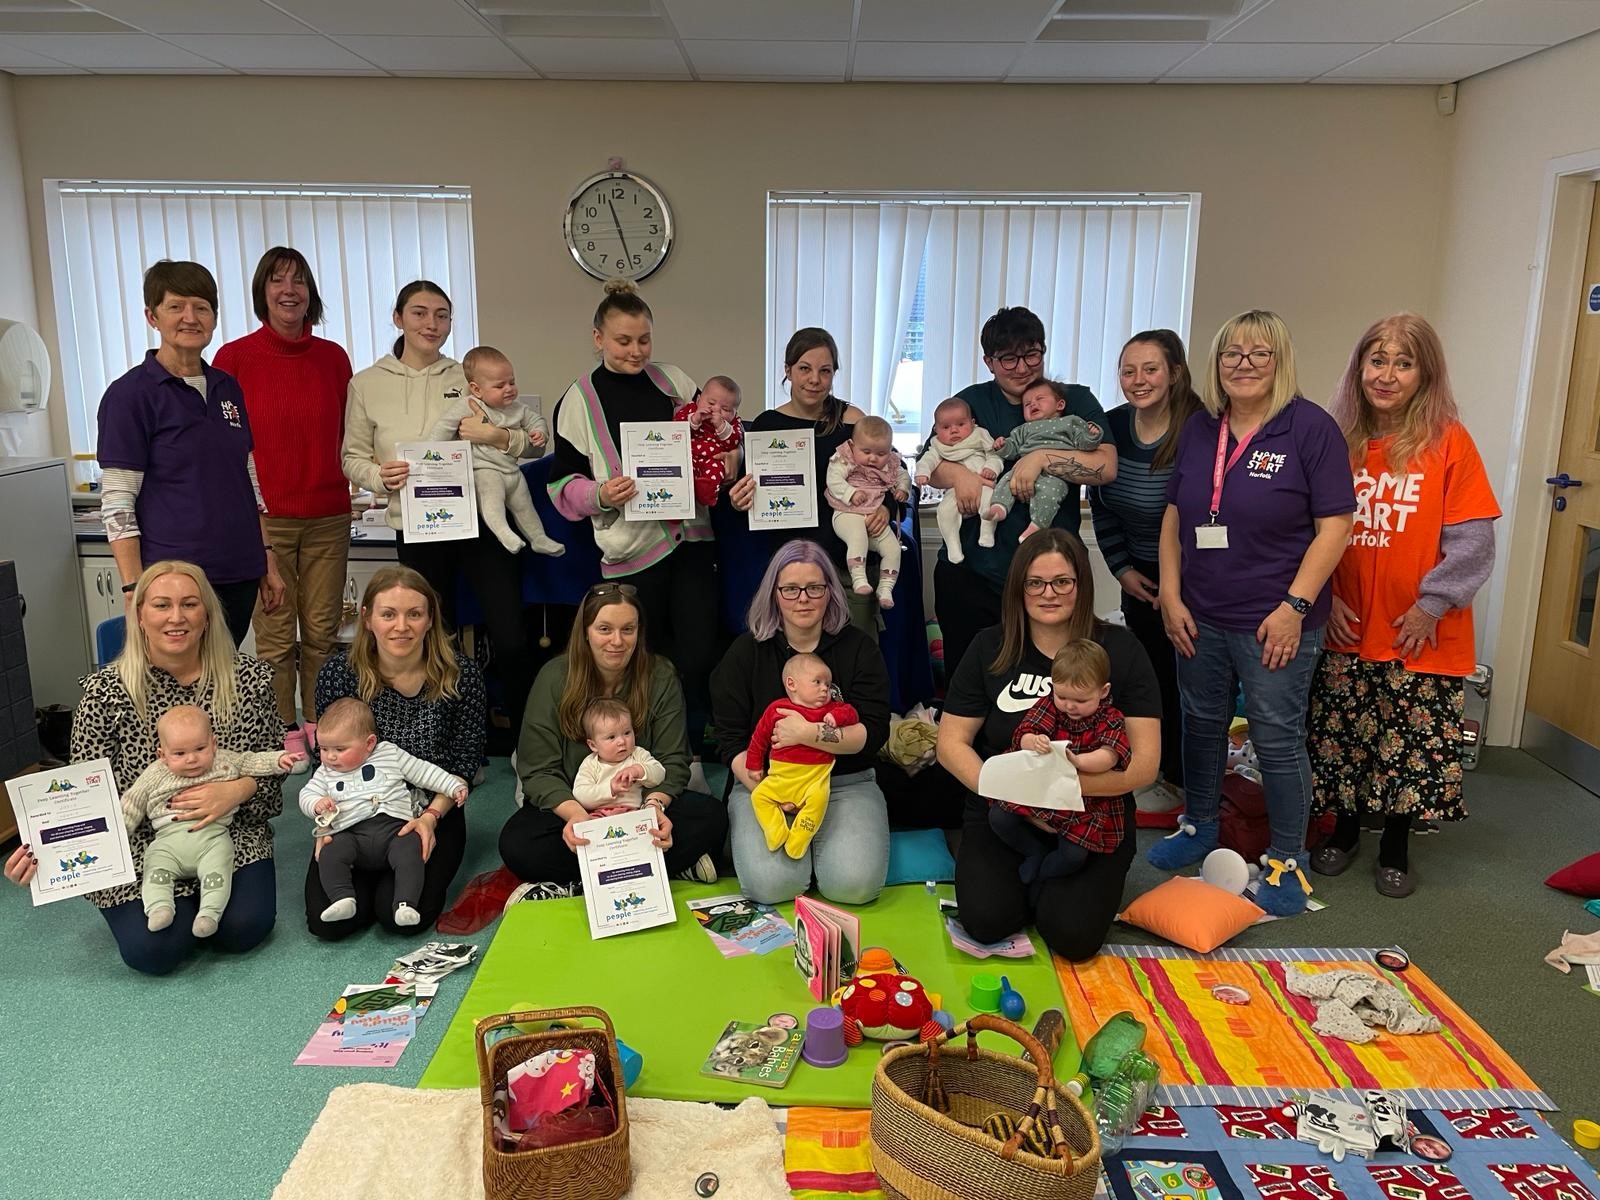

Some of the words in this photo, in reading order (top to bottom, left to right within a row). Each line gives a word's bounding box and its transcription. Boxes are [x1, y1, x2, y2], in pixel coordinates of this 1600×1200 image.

[598, 193, 606, 204] 11
[611, 188, 625, 200] 12
[633, 194, 638, 205] 1
[585, 207, 597, 218] 10
[643, 207, 653, 219] 2
[581, 223, 590, 234] 9
[649, 224, 659, 235] 3
[587, 241, 595, 251] 8
[643, 242, 653, 252] 4
[600, 254, 608, 264] 7
[616, 259, 625, 269] 6
[633, 255, 641, 265] 5
[1252, 450, 1287, 464] HOME
[1247, 459, 1283, 473] START
[1249, 471, 1272, 480] Norfolk
[1353, 468, 1424, 502] OME
[1011, 673, 1052, 697] JUS
